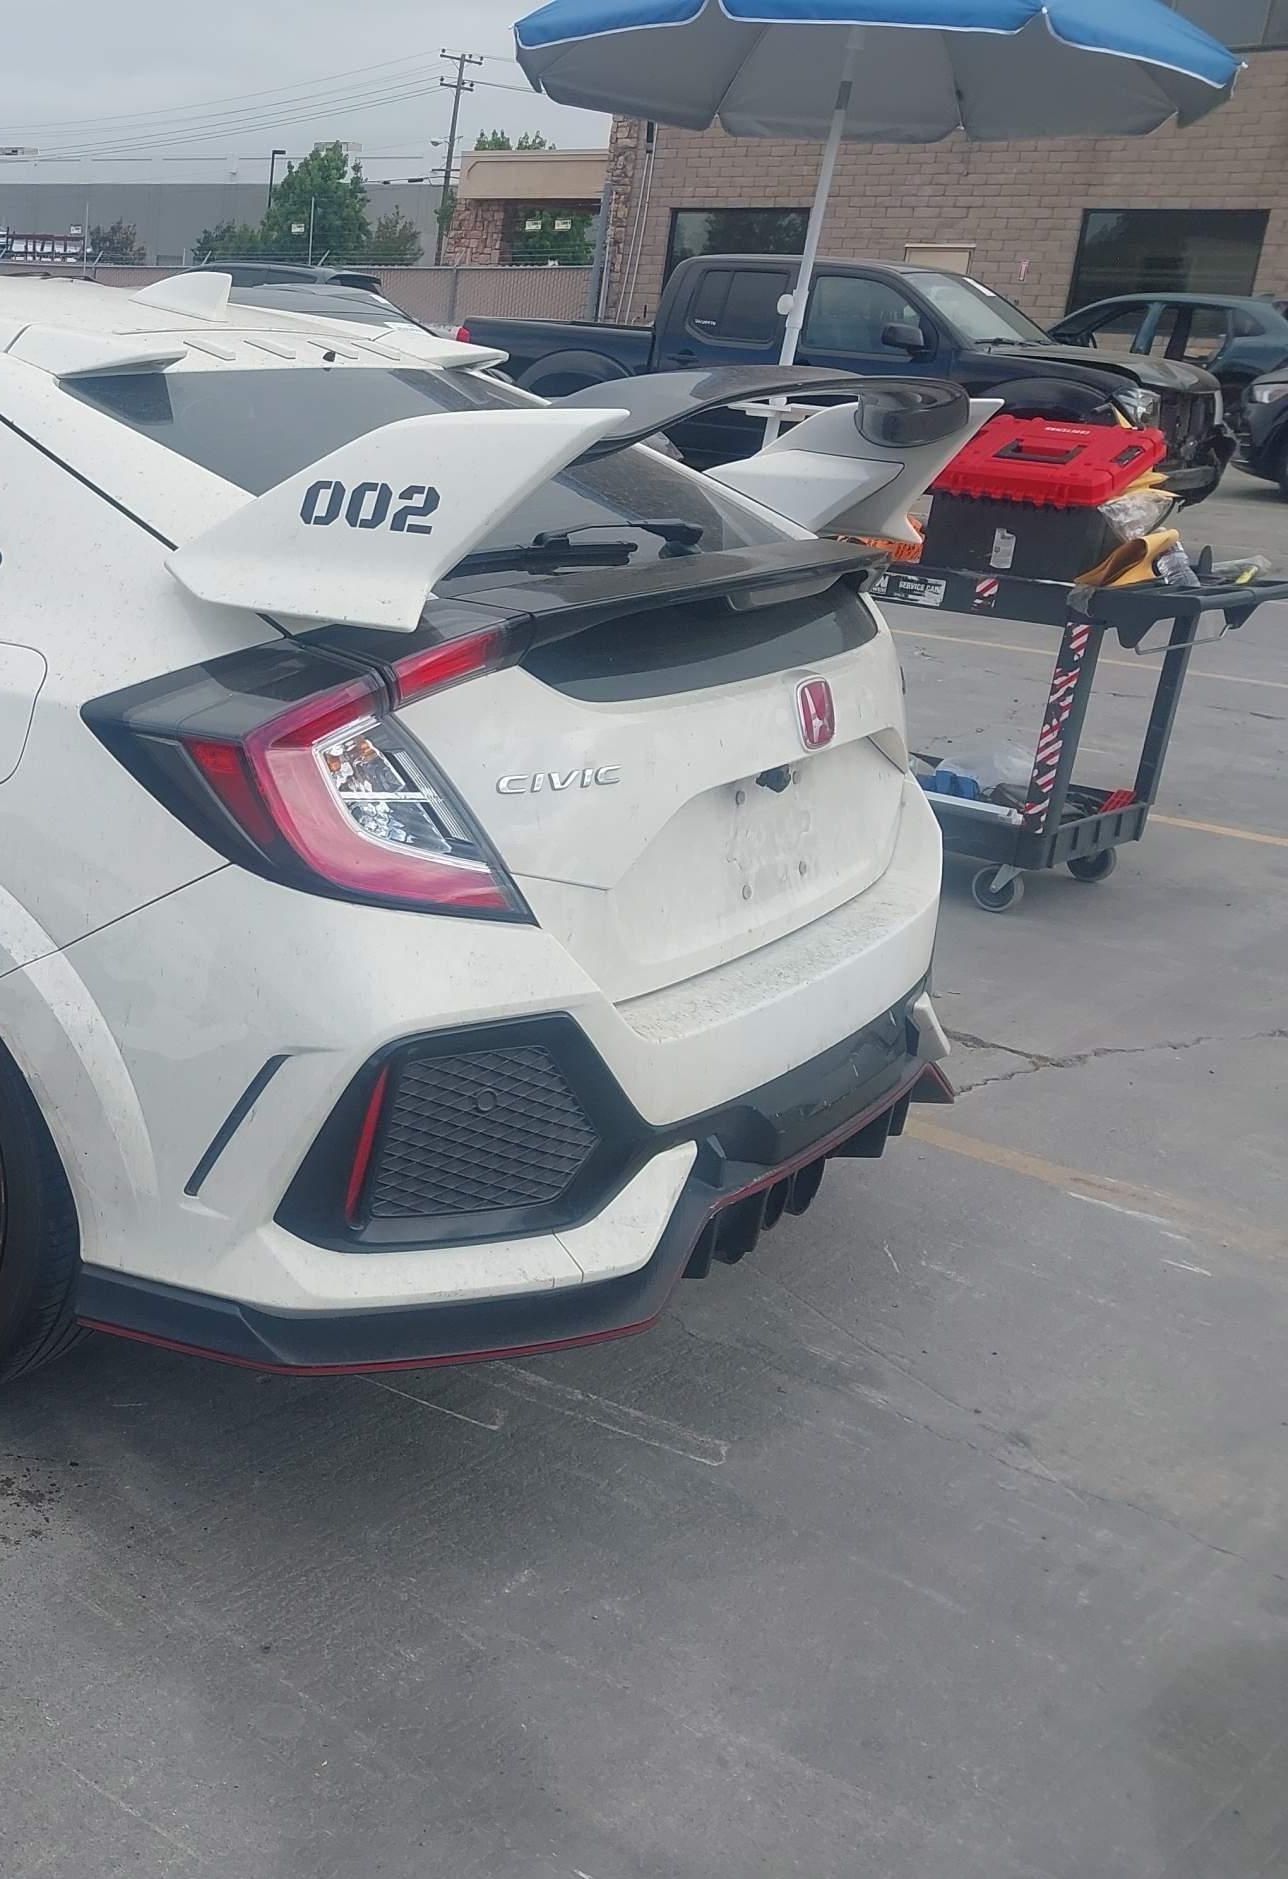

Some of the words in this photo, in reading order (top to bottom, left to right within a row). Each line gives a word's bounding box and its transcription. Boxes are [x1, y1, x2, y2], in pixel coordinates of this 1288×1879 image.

[300, 480, 441, 535] 002
[899, 581, 925, 592] SERVICE
[496, 764, 622, 795] CIVIC
